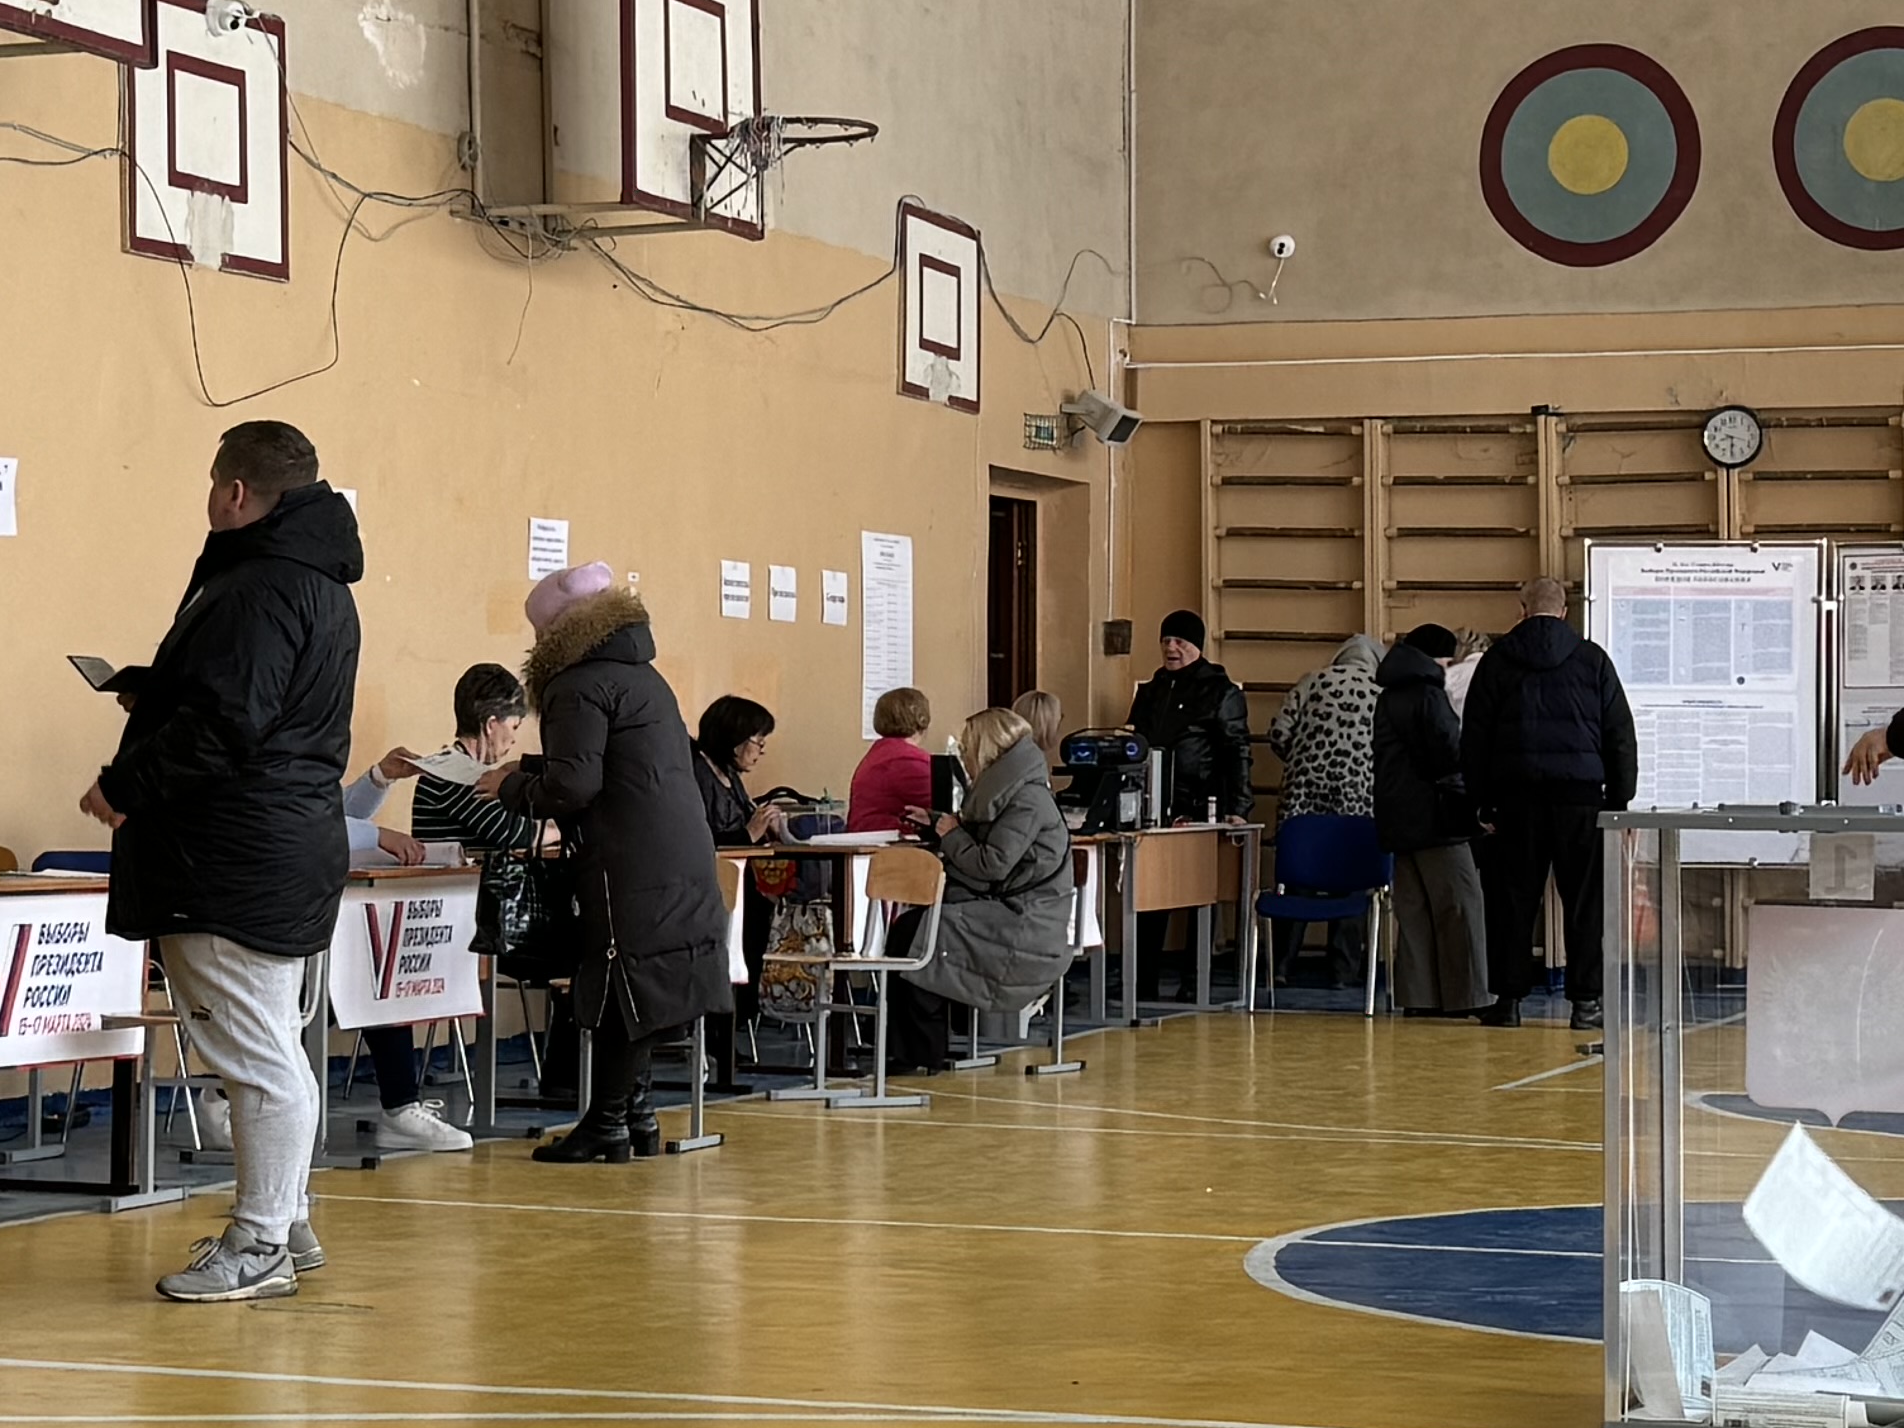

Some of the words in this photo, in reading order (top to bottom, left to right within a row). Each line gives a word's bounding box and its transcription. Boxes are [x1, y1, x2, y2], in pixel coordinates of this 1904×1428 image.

[407, 899, 443, 920] ВЫБОРЫ
[37, 921, 90, 945] ВЫБОРЫ
[403, 925, 453, 948] ПРЕЗИДЕНТА
[30, 951, 104, 977] ПРЕЗИДЕНТА
[398, 953, 432, 975] РОССИИ
[23, 984, 72, 1009] РОССИИ
